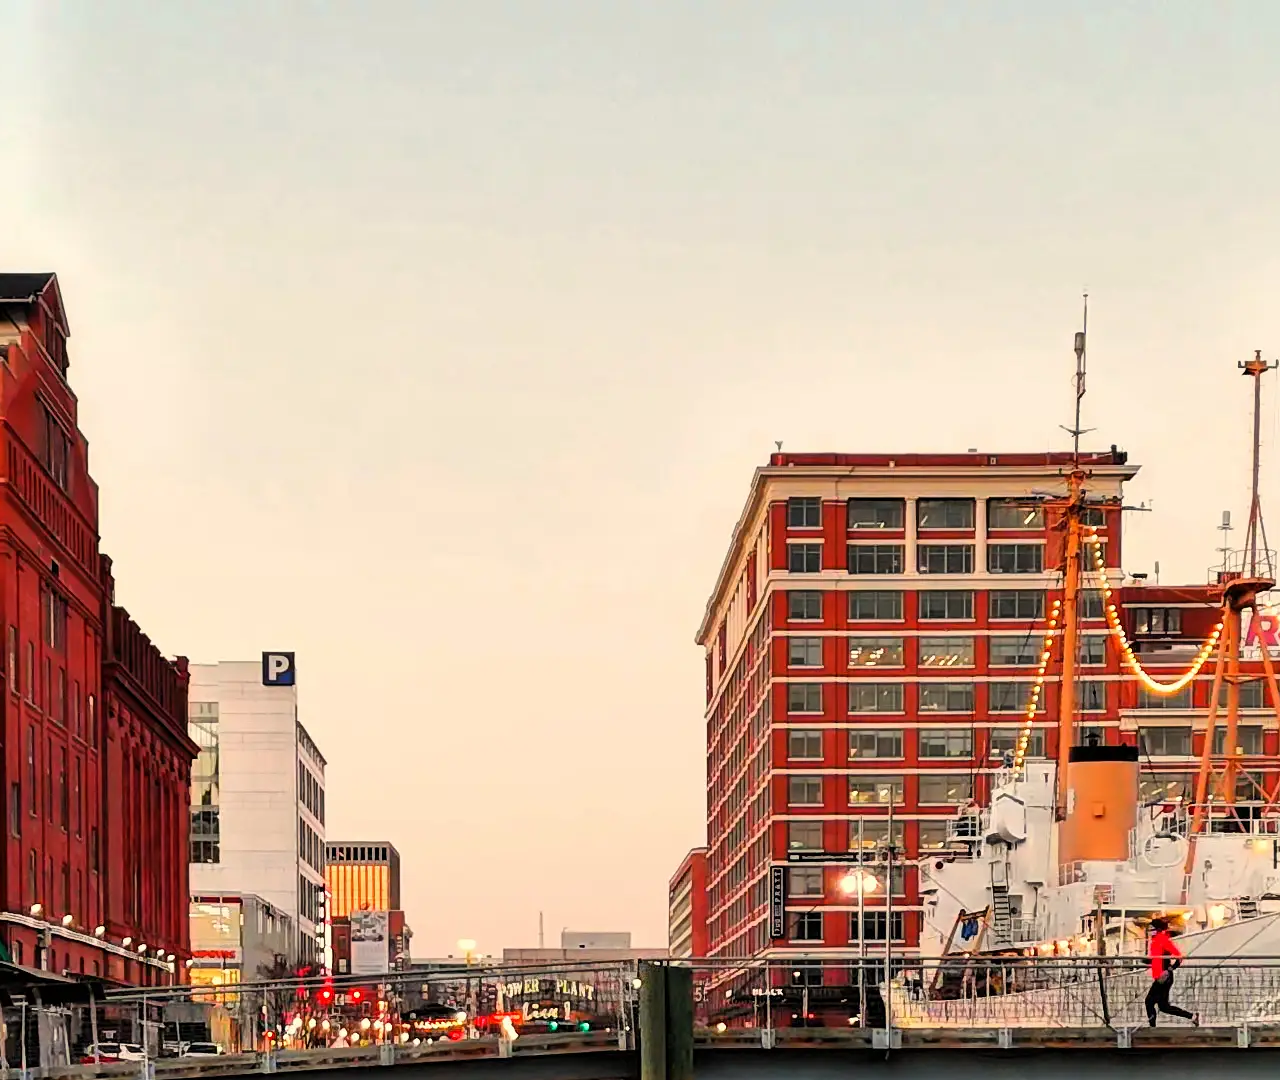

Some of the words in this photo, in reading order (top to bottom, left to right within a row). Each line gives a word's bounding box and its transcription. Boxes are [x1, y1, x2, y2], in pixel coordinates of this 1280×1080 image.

[269, 655, 289, 680] P
[499, 978, 539, 998] POWER
[556, 979, 595, 1000] PLANT
[752, 988, 784, 996] BLACK
